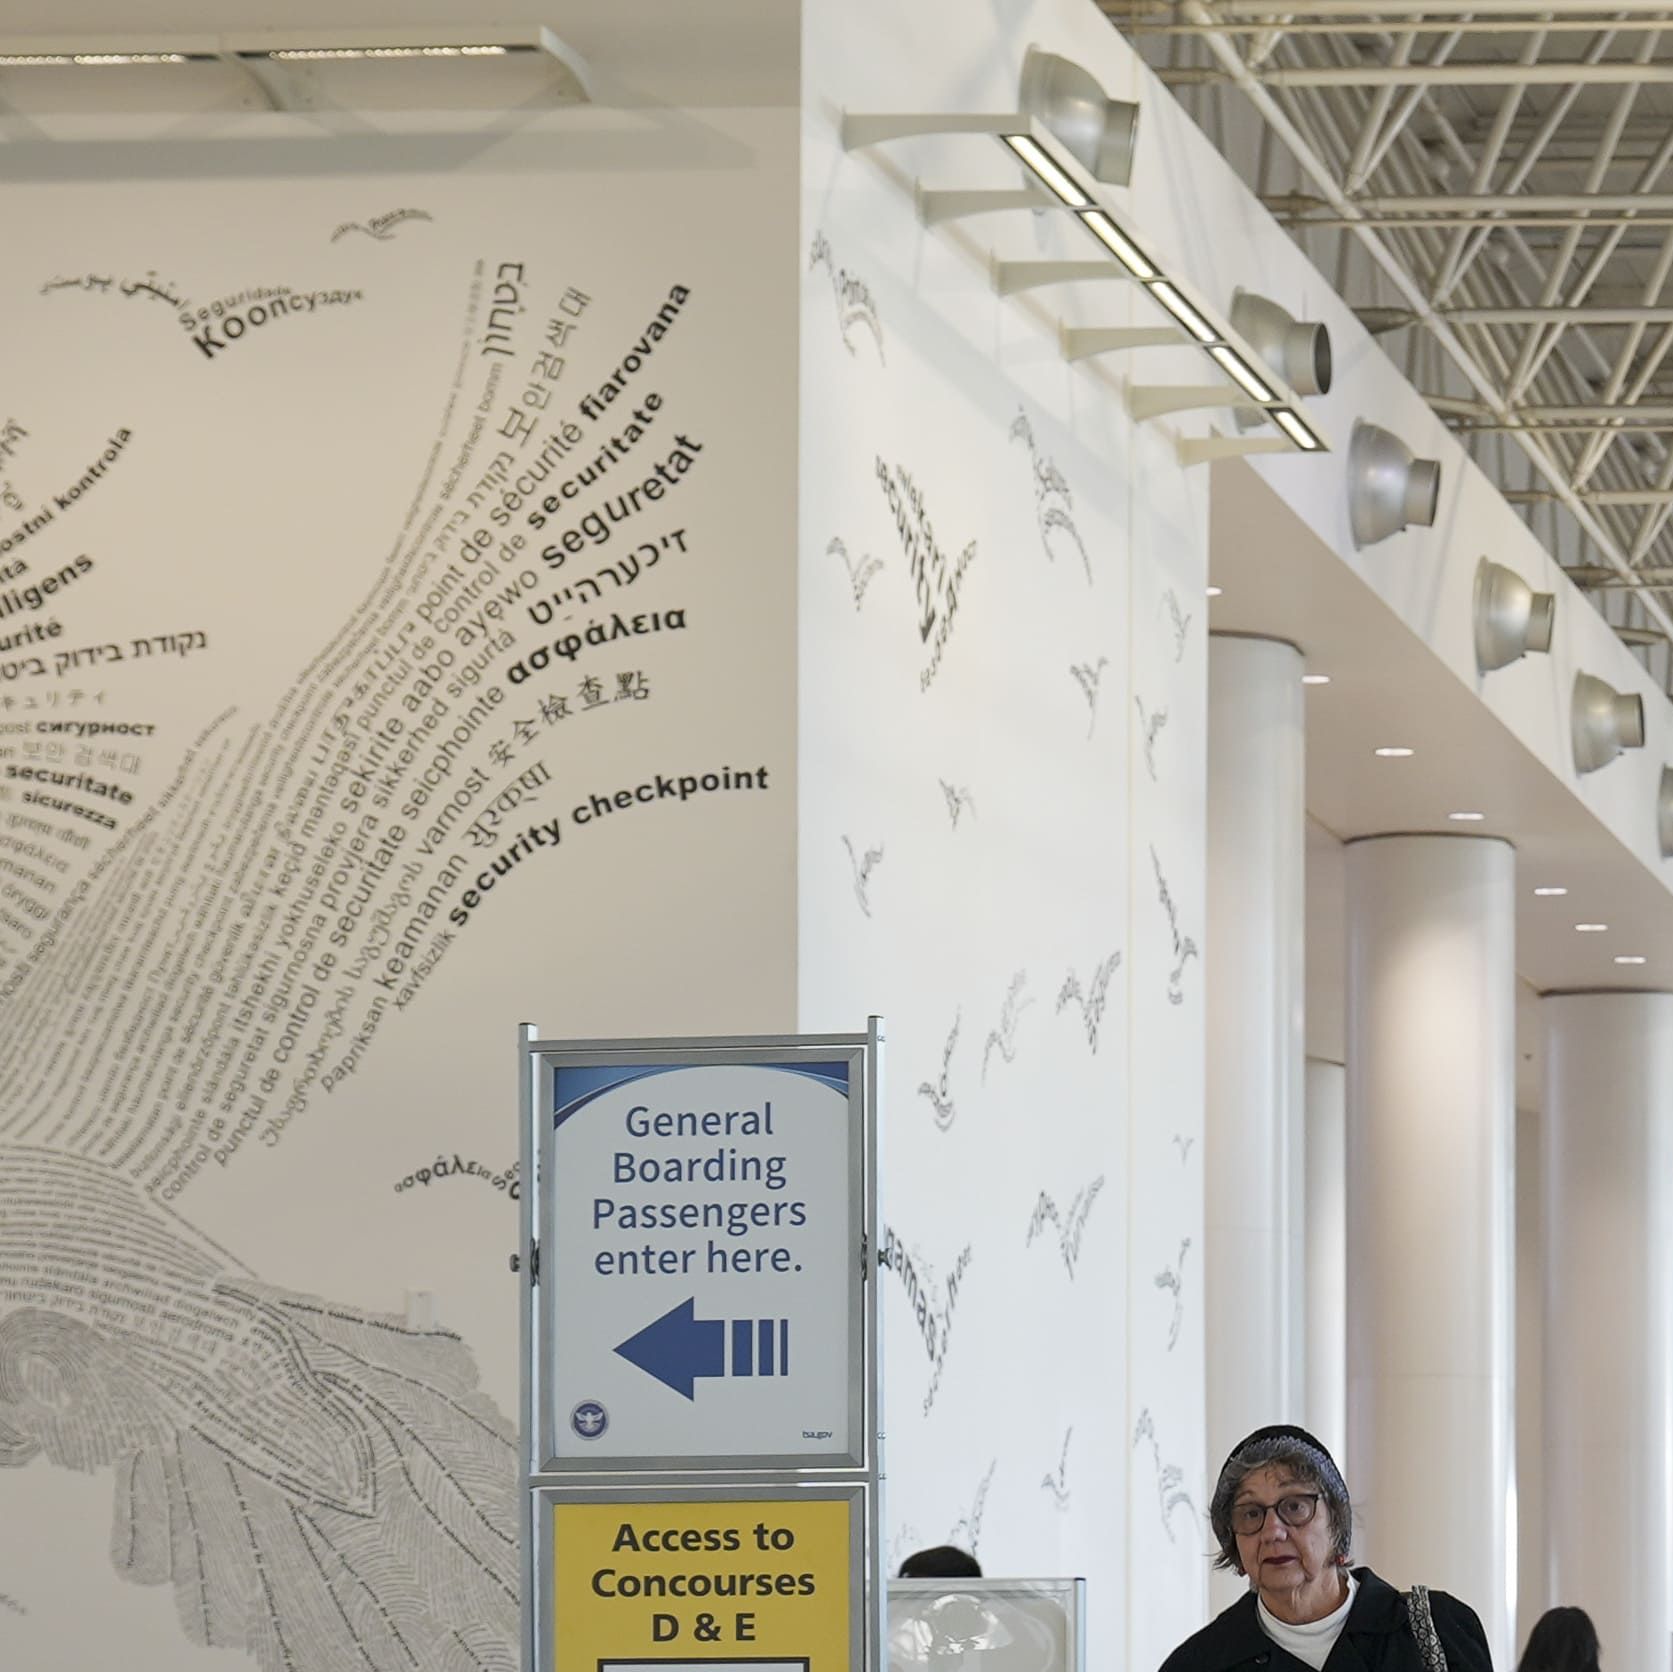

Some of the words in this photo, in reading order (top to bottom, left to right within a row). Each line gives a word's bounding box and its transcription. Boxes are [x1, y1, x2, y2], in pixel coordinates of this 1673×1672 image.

[579, 284, 691, 421] fiarovana
[527, 391, 664, 530] securitate
[340, 717, 404, 814] sekirite
[402, 649, 455, 713] aabo
[542, 434, 704, 569] seguretat
[6, 763, 133, 806] securitate
[22, 789, 118, 830] sicurezza
[417, 766, 490, 856] varnost
[273, 985, 320, 1064] control
[312, 952, 337, 982] de
[330, 825, 407, 947] securitate
[506, 605, 689, 686] ασφάλεια
[448, 817, 562, 928] security
[571, 765, 771, 826] checkpoint
[374, 853, 469, 990] keamanan
[626, 1102, 774, 1138] General
[613, 1148, 788, 1190] Boarding
[593, 1197, 808, 1236] Passengers
[594, 1243, 697, 1275] enter
[707, 1240, 803, 1274] here.
[612, 1524, 741, 1552] Access
[753, 1522, 795, 1551] to
[591, 1569, 816, 1598] Concourses
[652, 1615, 680, 1642] D
[693, 1613, 722, 1642] &
[735, 1613, 756, 1641] E
